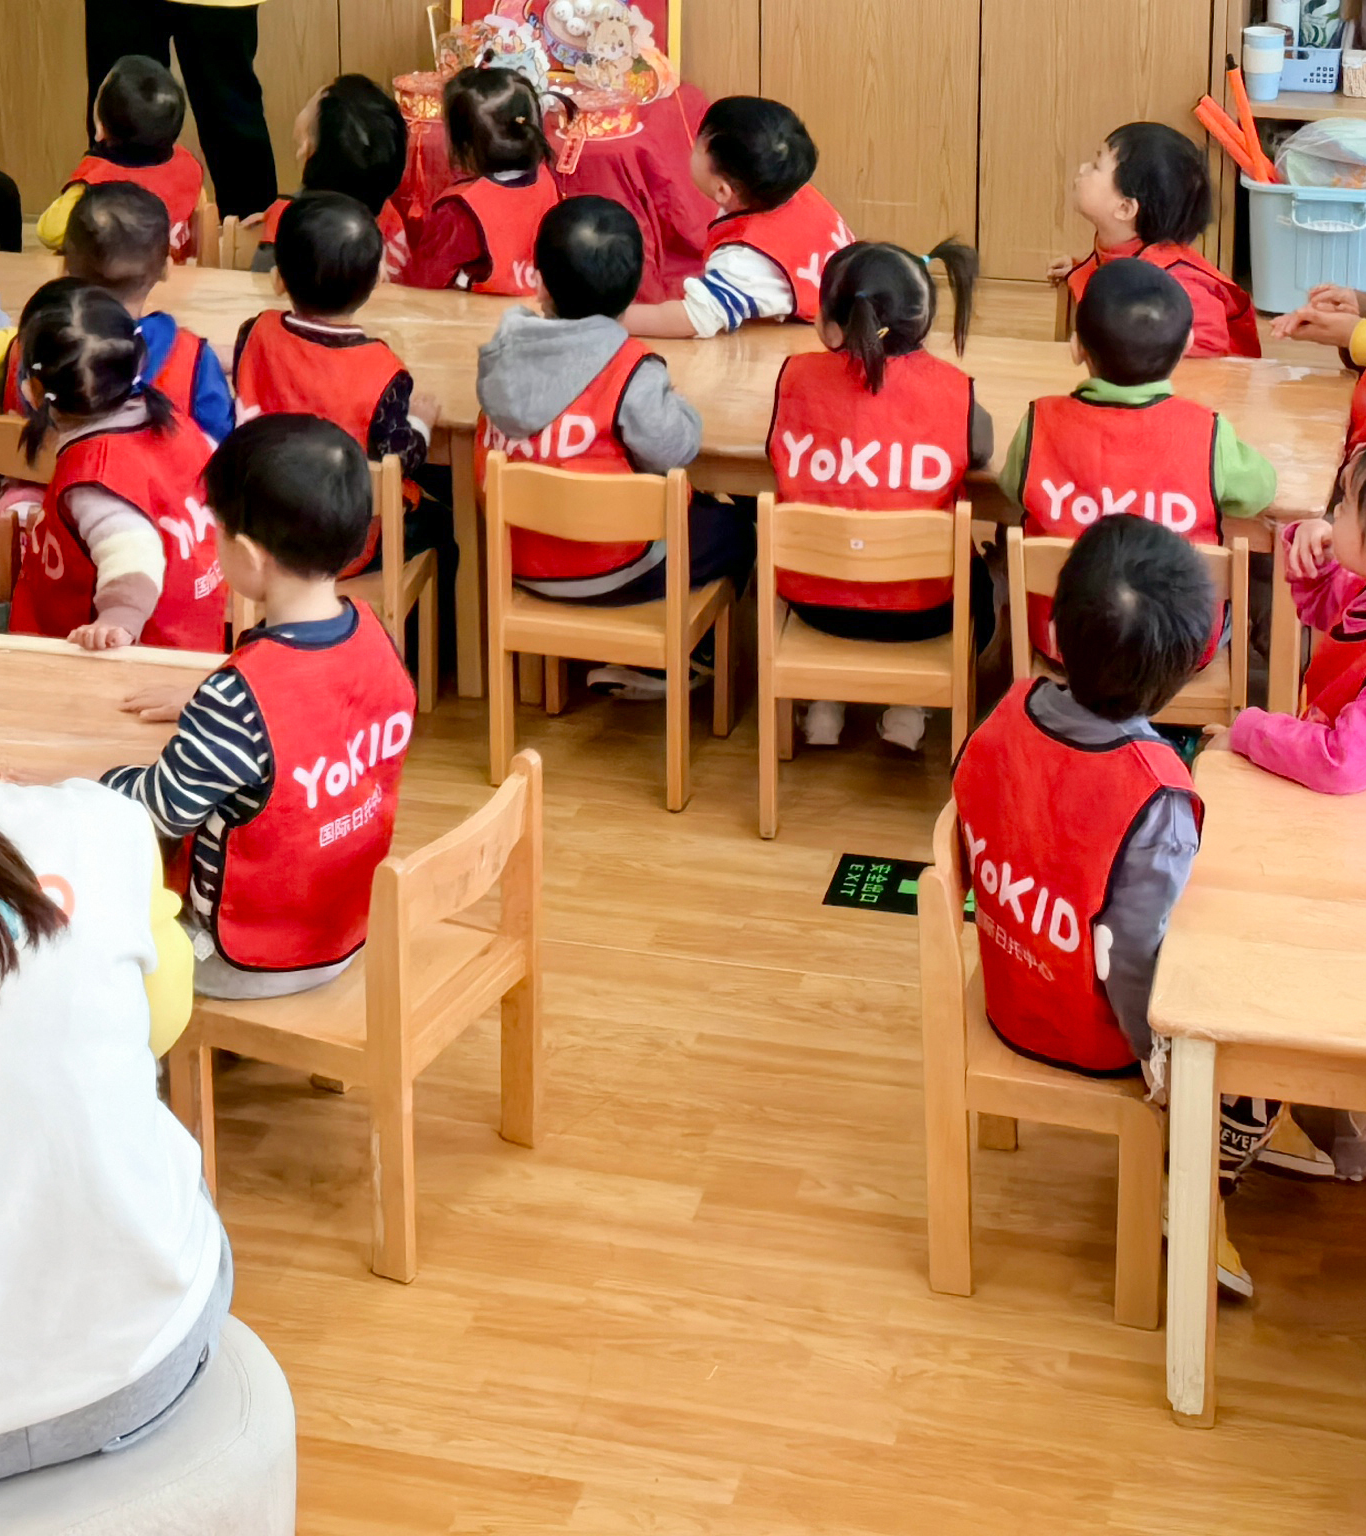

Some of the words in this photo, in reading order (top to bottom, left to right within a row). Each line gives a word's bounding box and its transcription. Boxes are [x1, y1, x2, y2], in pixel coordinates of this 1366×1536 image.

[781, 429, 954, 492] YoKID
[1040, 478, 1197, 534] YoKID
[291, 709, 413, 812] YoKID
[317, 782, 384, 850] 国际日托中心
[839, 863, 866, 897] EXIT
[859, 863, 893, 903] 安全出口
[962, 822, 1081, 953] YoKID
